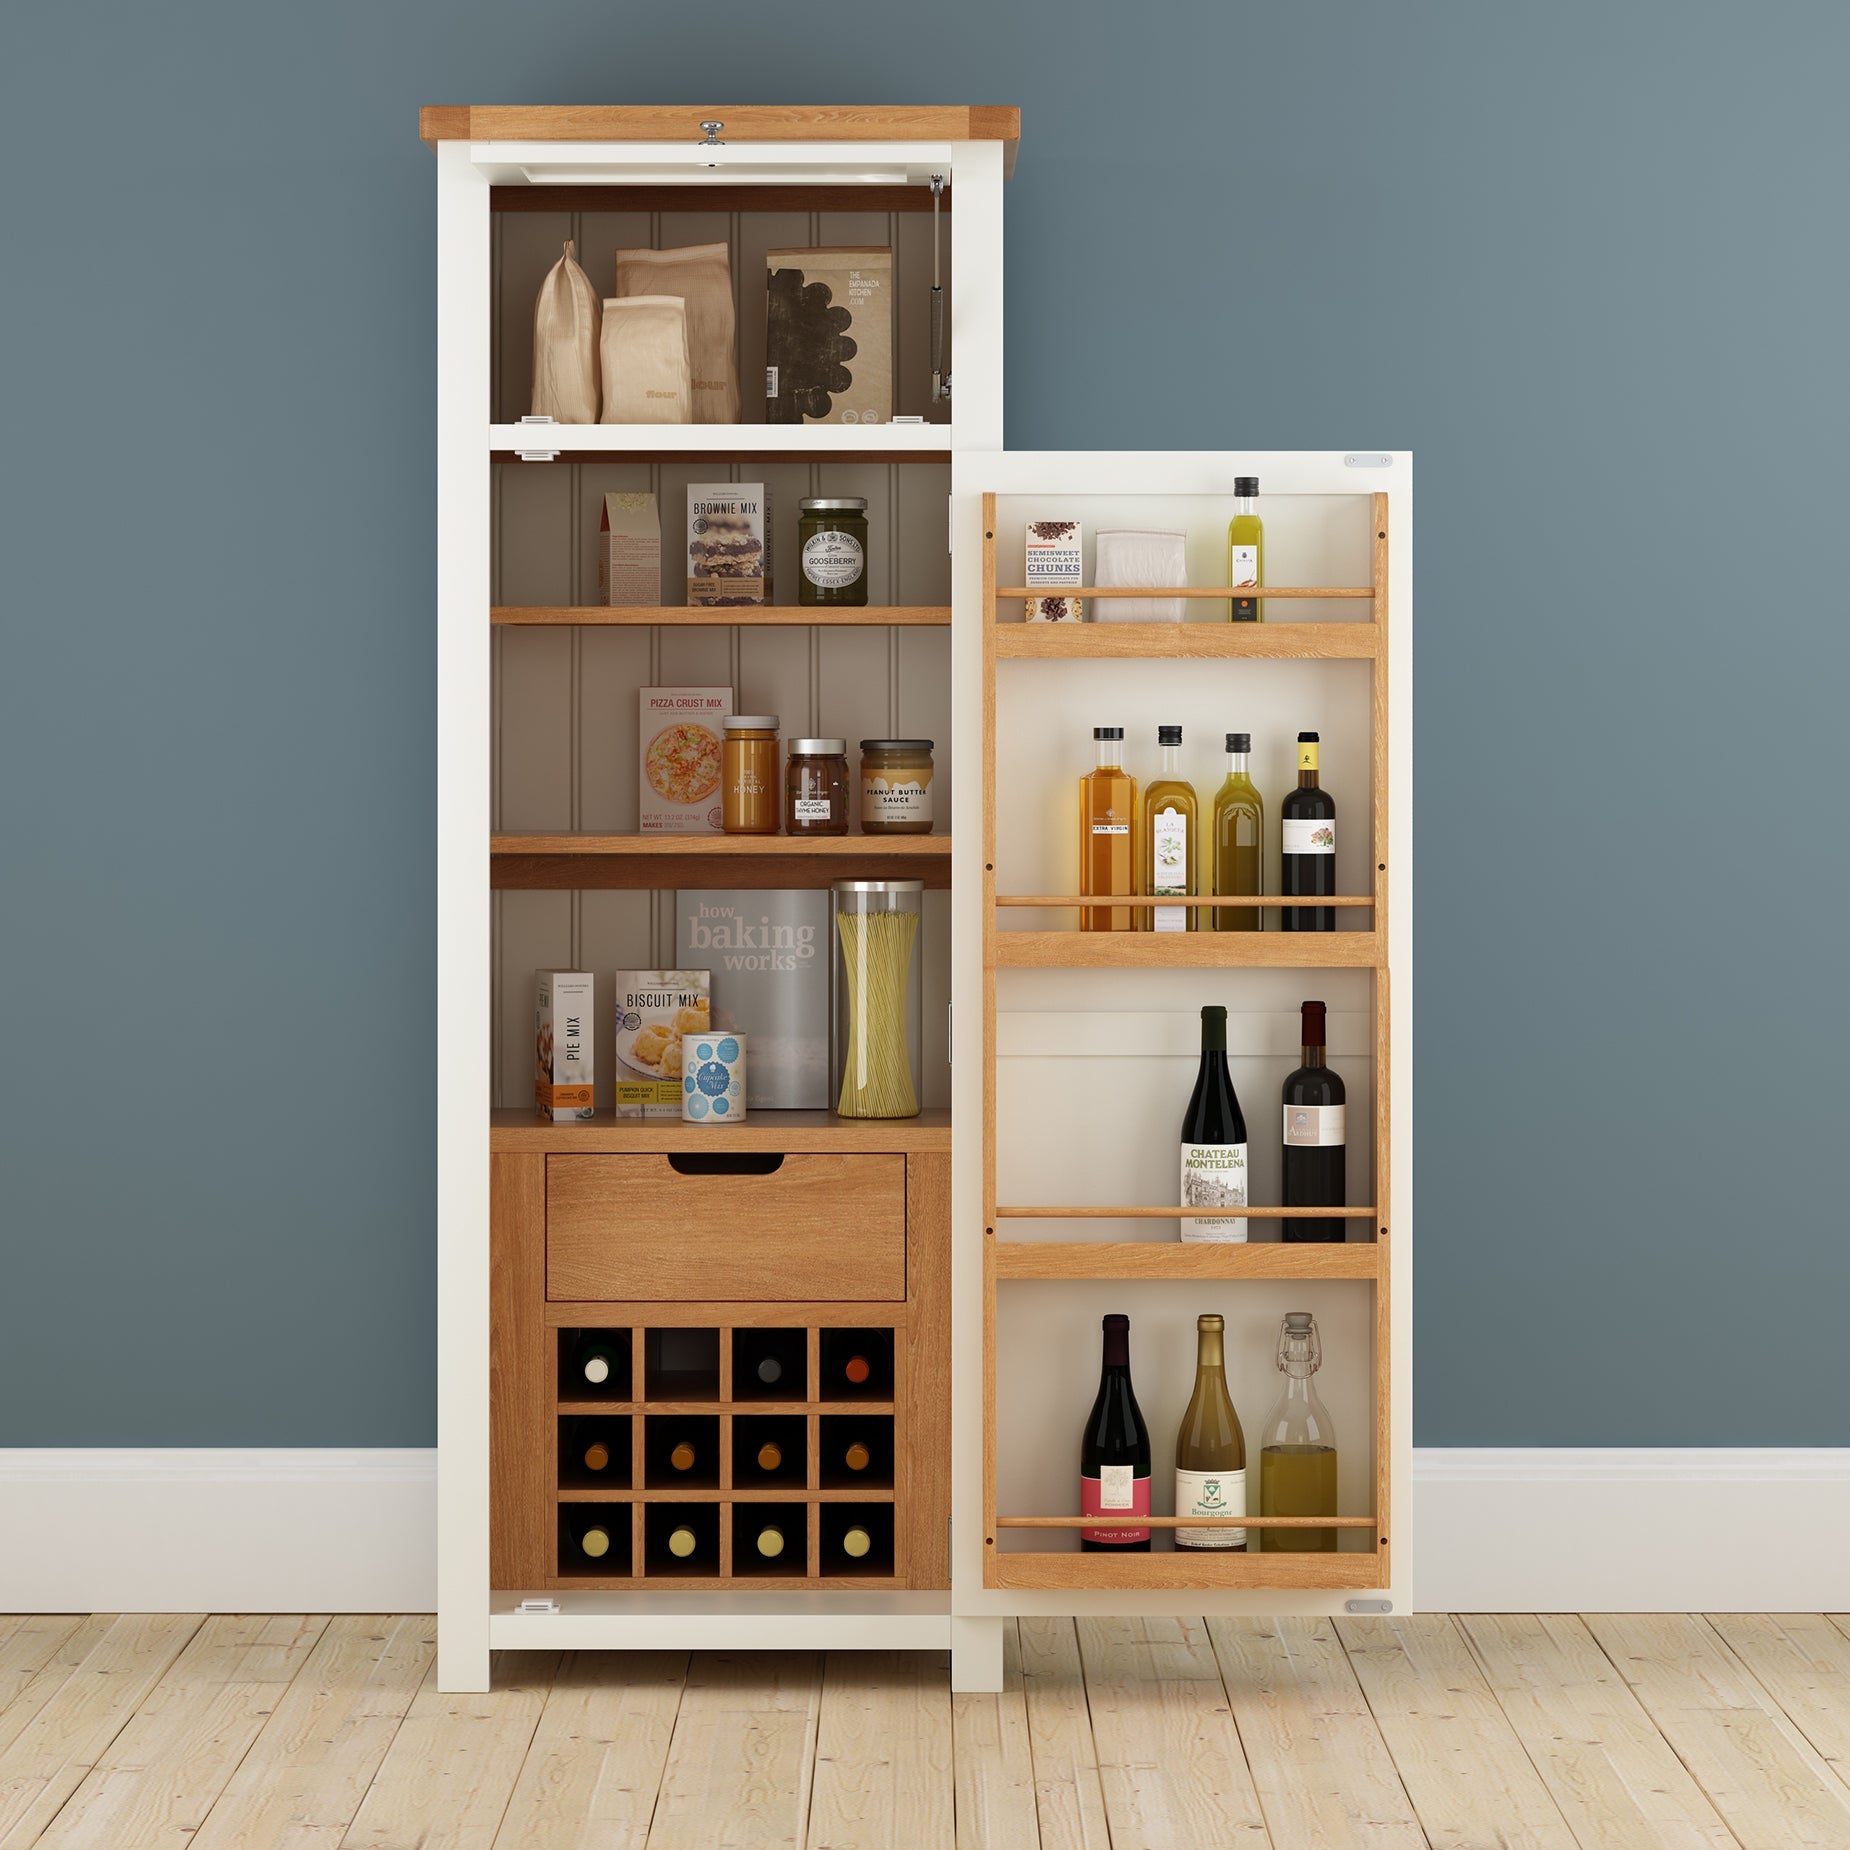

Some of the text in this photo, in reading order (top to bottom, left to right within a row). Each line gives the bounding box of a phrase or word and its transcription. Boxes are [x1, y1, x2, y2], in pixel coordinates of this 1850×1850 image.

[850, 271, 860, 279] THE
[646, 390, 677, 398] flour
[694, 502, 758, 514] BROWNIE MIX
[1028, 564, 1080, 572] CHUNKS
[650, 699, 722, 707] PIZZA CRUST MIX
[700, 903, 735, 918] how
[688, 916, 815, 958] baking
[723, 950, 796, 970] works
[627, 994, 698, 1007] BISCUIT MIX
[567, 1017, 580, 1060] PIE MIX
[698, 1073, 727, 1082] Cupcake
[710, 1081, 724, 1089] Mix
[1191, 1149, 1239, 1158] CHATEAU
[1186, 1159, 1244, 1168] MONTELENA
[1192, 1508, 1232, 1516] Bourgogne
